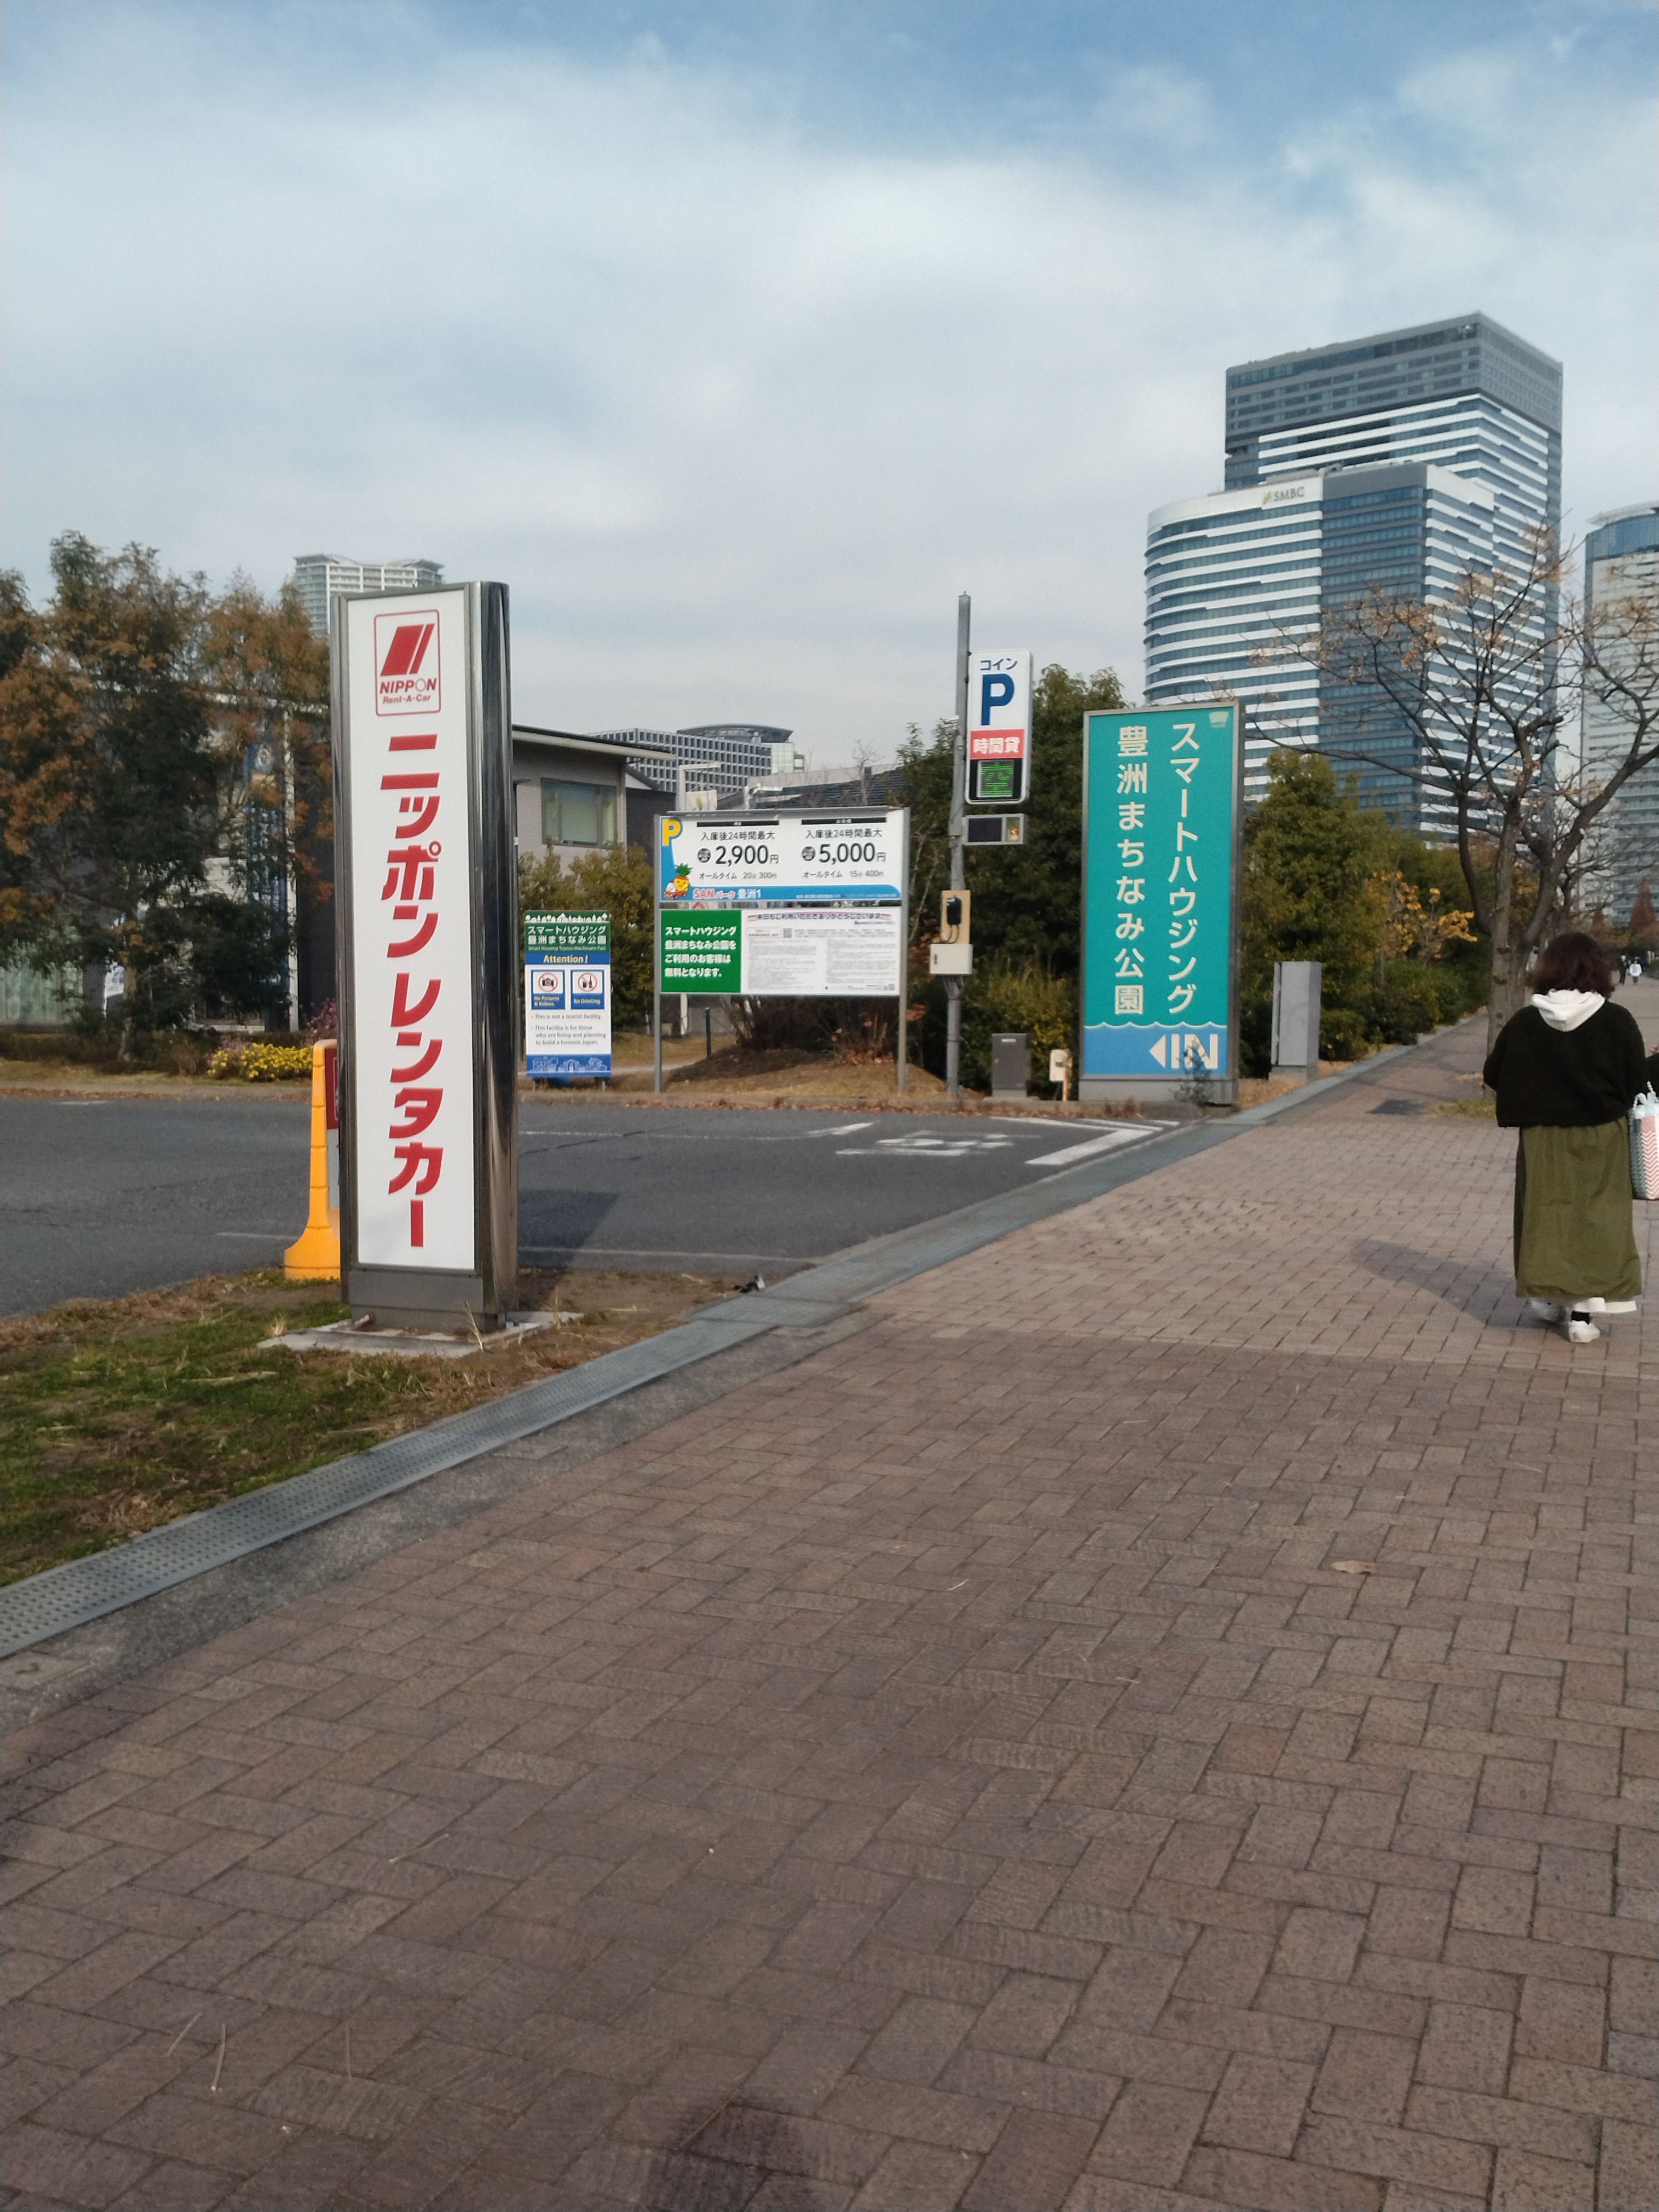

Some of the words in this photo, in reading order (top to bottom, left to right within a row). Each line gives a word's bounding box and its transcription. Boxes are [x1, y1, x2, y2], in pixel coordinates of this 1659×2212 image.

[1274, 486, 1304, 501] SMBC
[980, 658, 1018, 671] コイン
[380, 677, 437, 694] NIPPON
[382, 694, 431, 705] Rent-A-Car
[981, 673, 1015, 725] P
[973, 737, 1020, 754] 時間貸
[981, 761, 1013, 795] 空
[662, 819, 681, 846] P
[700, 831, 775, 841] 入庫後24時間最大
[805, 828, 883, 839] 入庫後24時間最大
[1114, 725, 1149, 1015] 豊洲まちなみ公園
[1167, 723, 1201, 1014] スマートハウジング
[528, 925, 606, 934] スマートハウジング
[665, 926, 736, 936] スマートハウジング
[528, 935, 606, 944] 豊洲まちなみ公園
[665, 940, 736, 950] 豊洲まちなみ公園を
[665, 954, 731, 963] ご利用のお客様は
[665, 967, 722, 977] 無料となります。
[1171, 1034, 1219, 1070] IN
